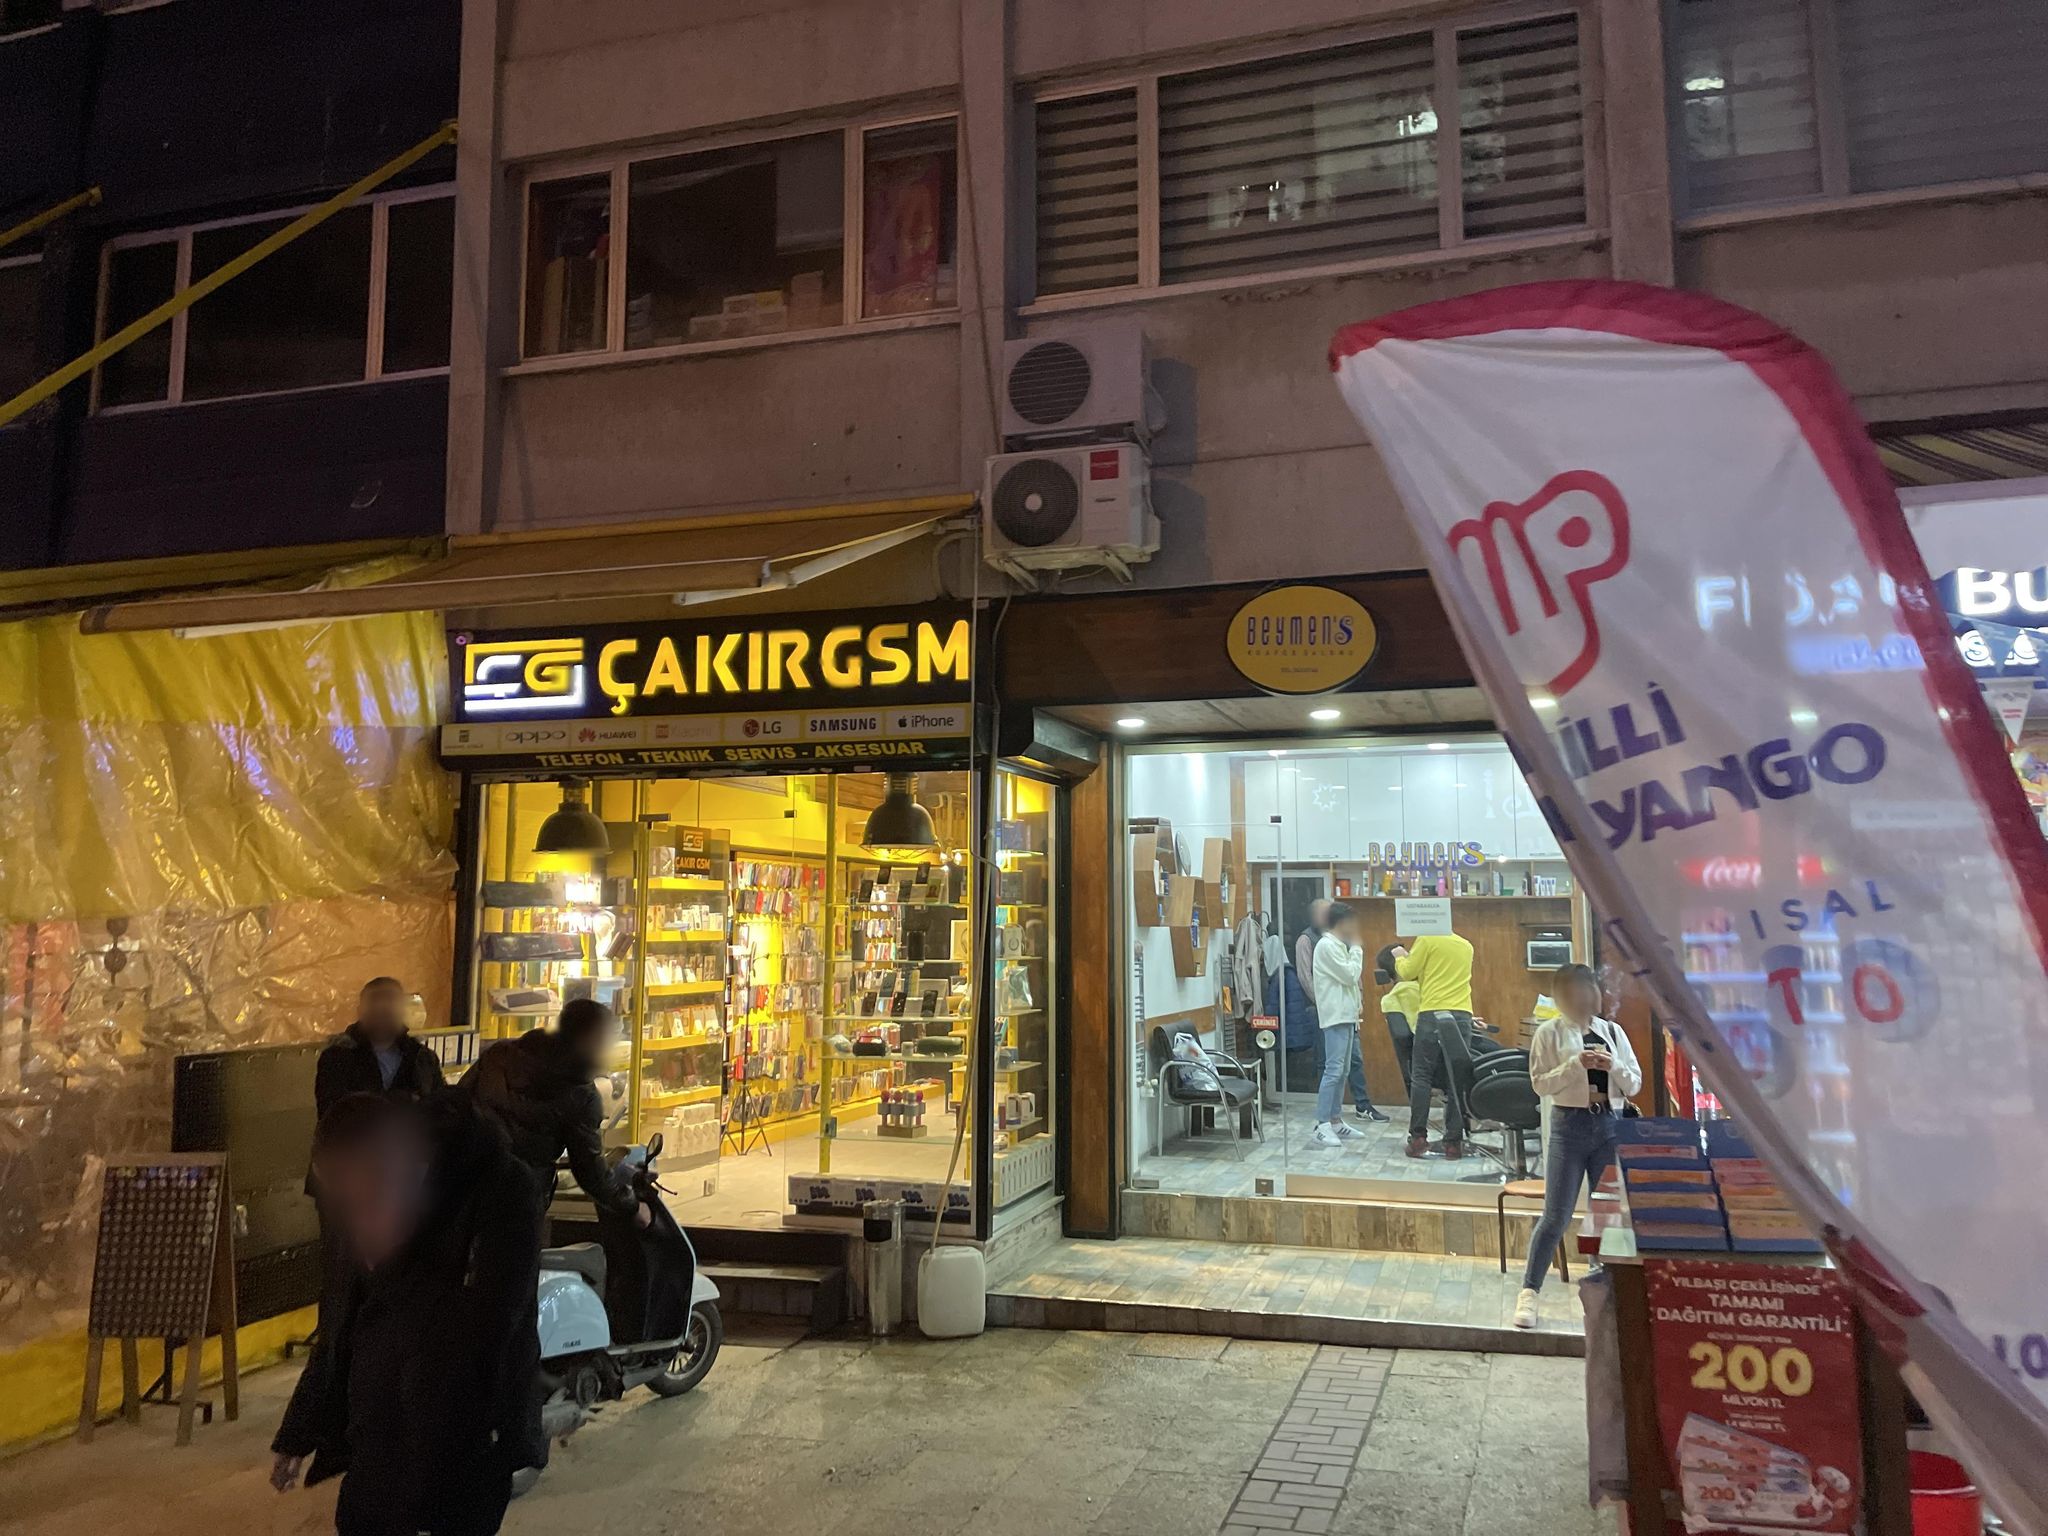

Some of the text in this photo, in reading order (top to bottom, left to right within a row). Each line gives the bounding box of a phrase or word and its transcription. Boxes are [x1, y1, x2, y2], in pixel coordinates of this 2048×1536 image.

[762, 720, 782, 735] LG
[809, 717, 877, 733] SAMSUNG
[911, 714, 955, 728] iPhone
[536, 752, 624, 768] TELEFON
[814, 741, 926, 759] AKSESUAR
[1540, 722, 1887, 850] YANGO
[1749, 880, 1895, 940] ISAL
[1707, 1293, 1785, 1311] TAMAMI
[1657, 1306, 1841, 1333] DAĞITIM GARANTİLİ
[1688, 1341, 1814, 1397] 200
